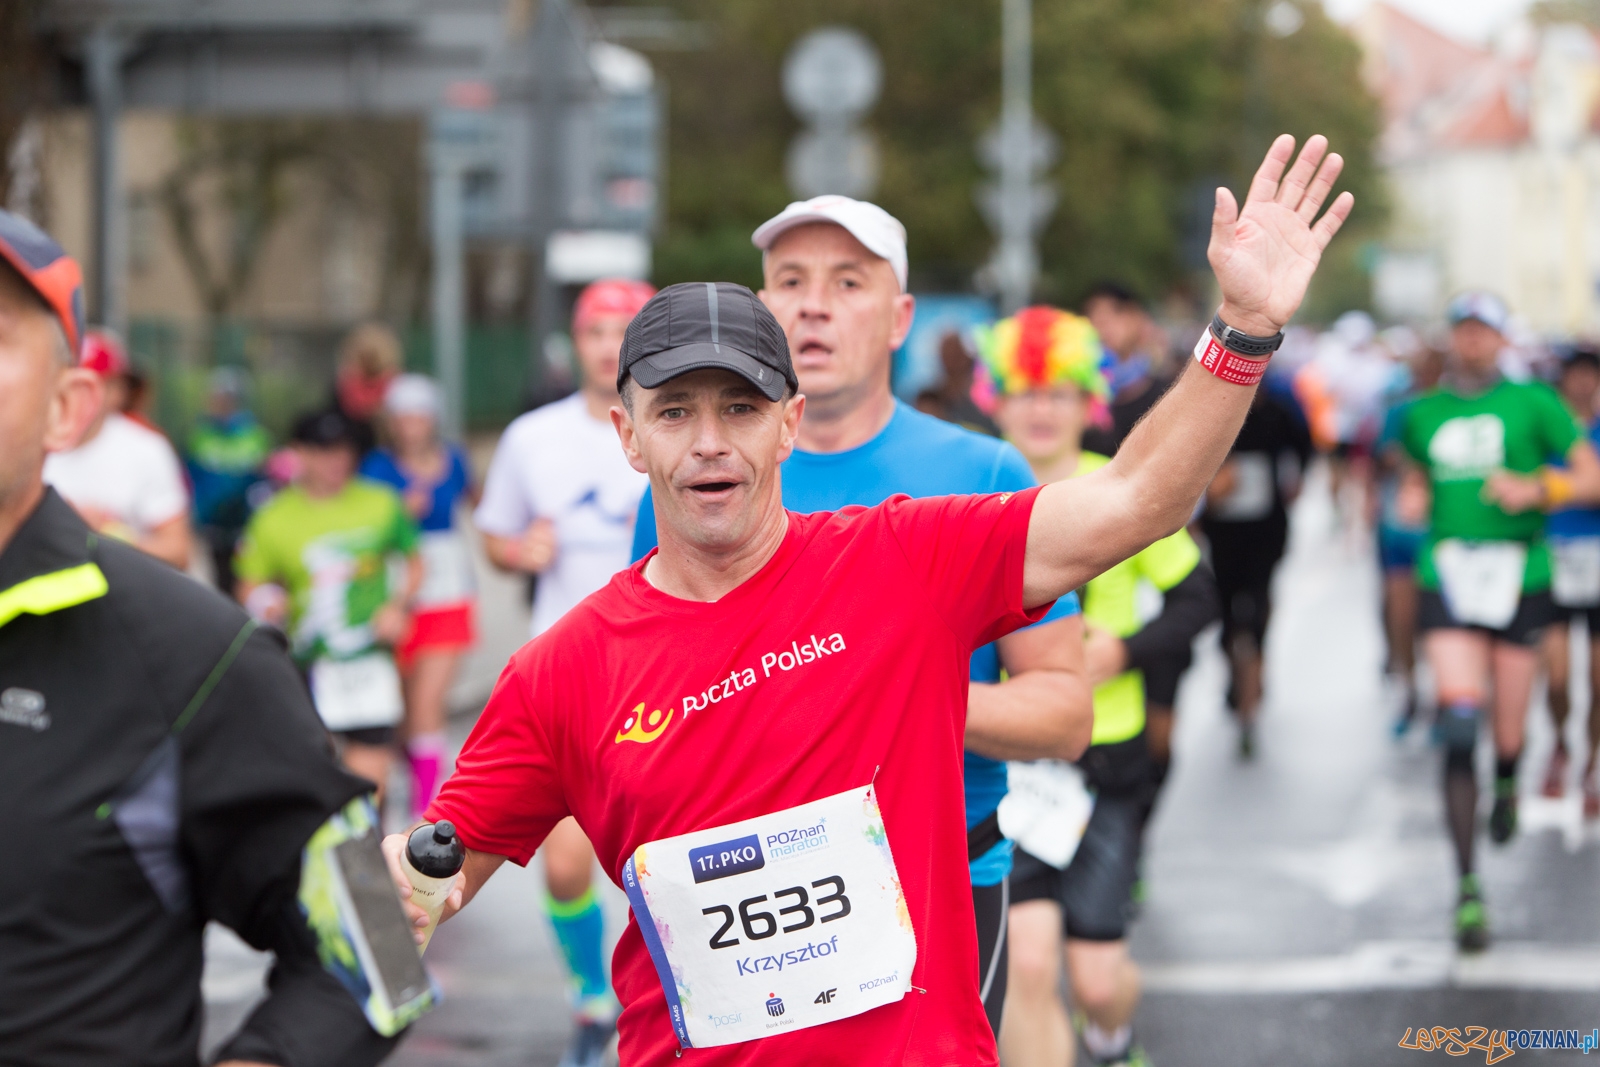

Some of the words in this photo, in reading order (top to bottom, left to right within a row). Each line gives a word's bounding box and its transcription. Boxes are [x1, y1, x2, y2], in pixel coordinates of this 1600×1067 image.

[1203, 344, 1220, 368] START
[682, 667, 757, 720] Poczta
[761, 632, 847, 678] Polska
[769, 834, 829, 859] maraton
[701, 875, 852, 950] 2633
[736, 935, 839, 977] Krzysztof
[813, 987, 838, 1005] 4F
[672, 1004, 681, 1022] M45
